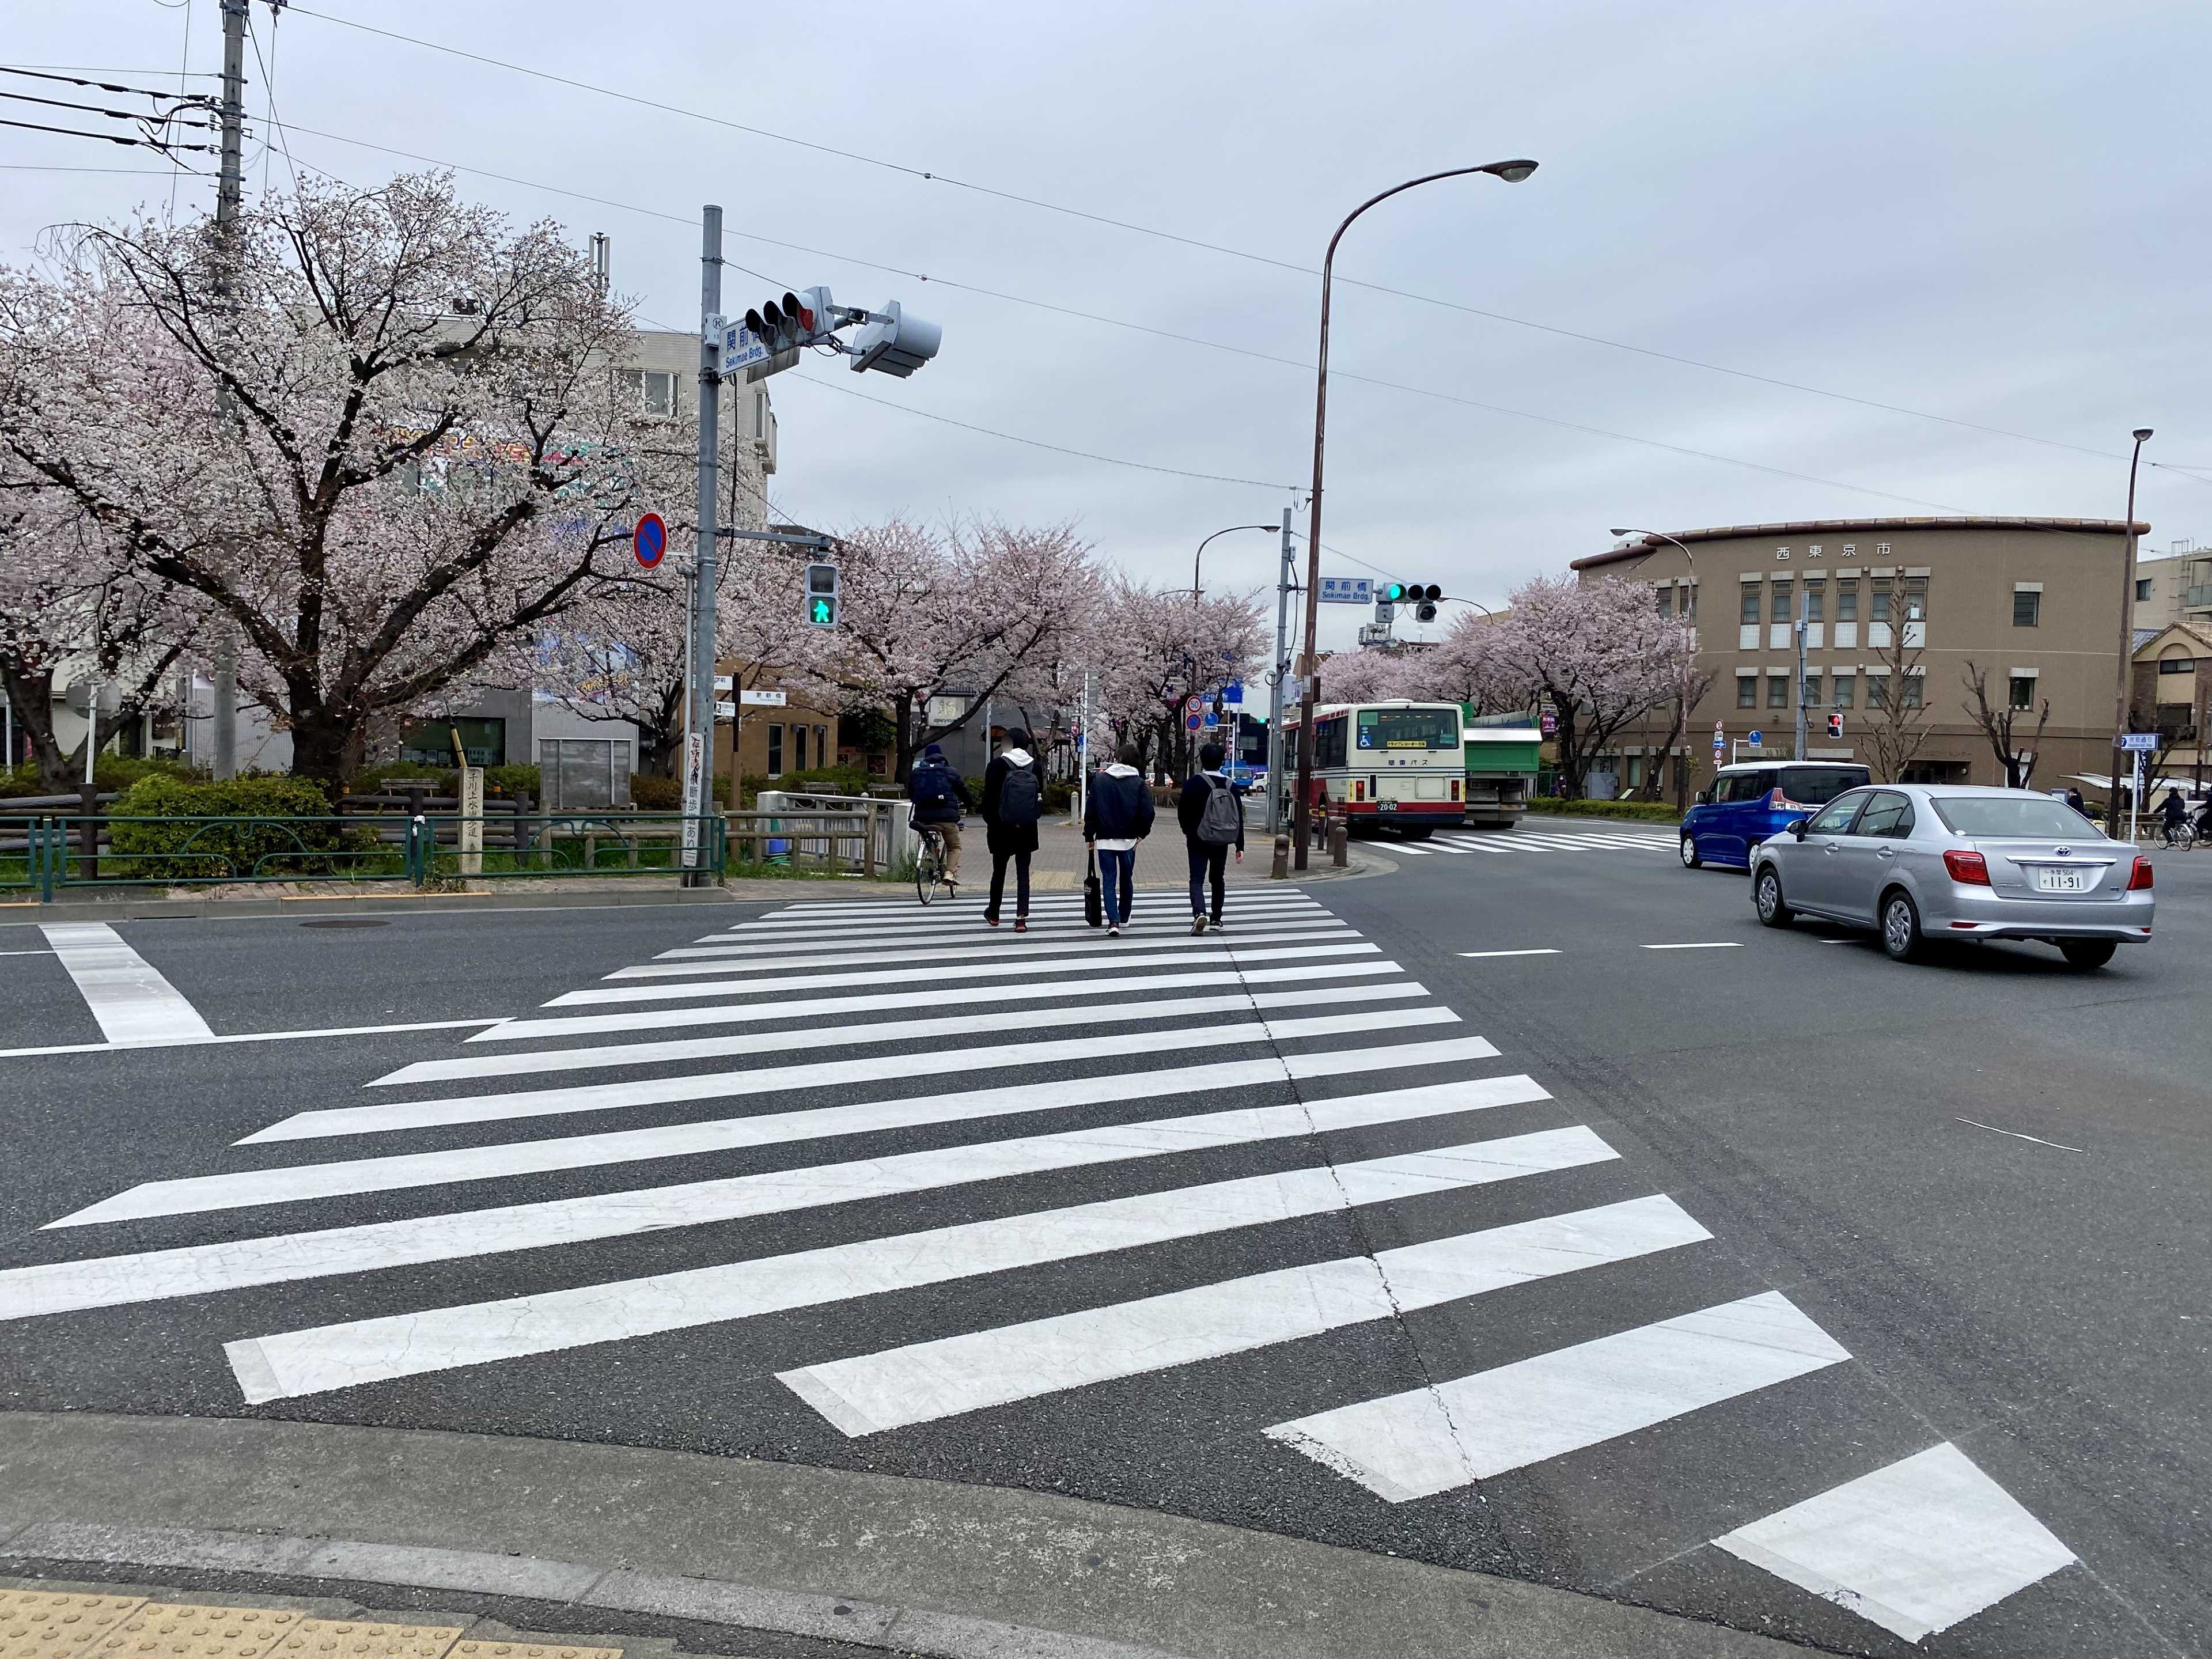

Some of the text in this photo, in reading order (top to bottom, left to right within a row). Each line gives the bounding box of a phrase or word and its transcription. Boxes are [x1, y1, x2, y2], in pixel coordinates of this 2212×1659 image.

[726, 346, 763, 369] Sekimae Brdg.
[1777, 541, 1891, 560] 西東京市
[1325, 581, 1366, 592] 関前橋
[1353, 592, 1369, 601] Brdg.
[2051, 876, 2080, 888] 11-91
